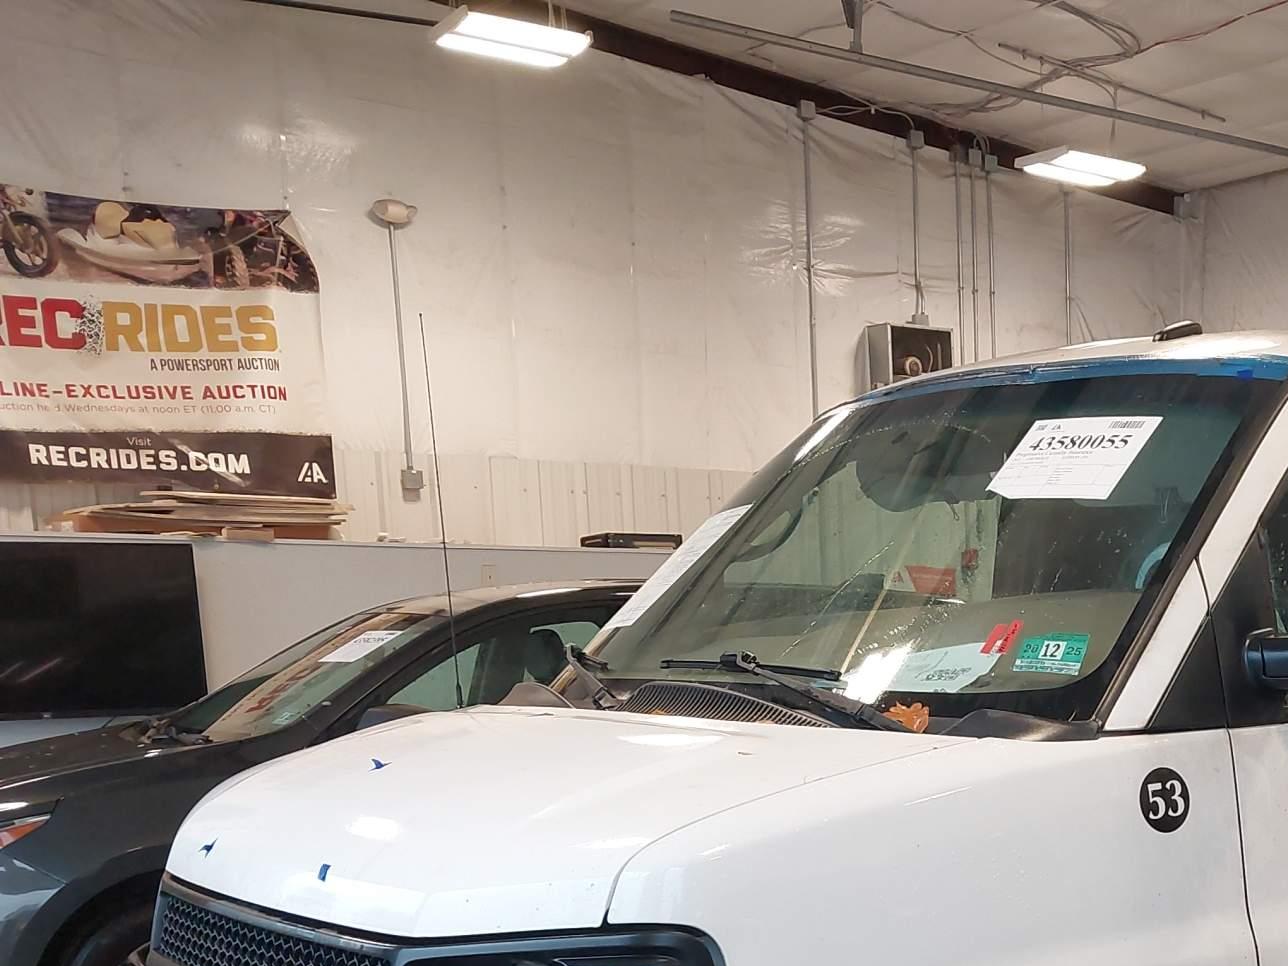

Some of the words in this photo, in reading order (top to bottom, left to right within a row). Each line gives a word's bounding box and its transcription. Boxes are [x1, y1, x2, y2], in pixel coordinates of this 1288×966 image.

[0, 294, 86, 350] EC
[102, 301, 280, 353] RIDES
[150, 359, 158, 371] A
[160, 358, 234, 372] POWERSPORT
[237, 359, 280, 372] AUCTION
[202, 384, 288, 401] AUCTION
[138, 405, 149, 413] at
[152, 405, 180, 414] noon
[183, 405, 196, 413] ET
[258, 404, 276, 414] CT)
[126, 436, 151, 446] Visit
[1029, 434, 1133, 451] 43580055
[28, 444, 251, 474] RECRIDES.COM
[1041, 643, 1061, 658] 12
[1066, 646, 1083, 656] 25
[1146, 779, 1187, 822] 53
